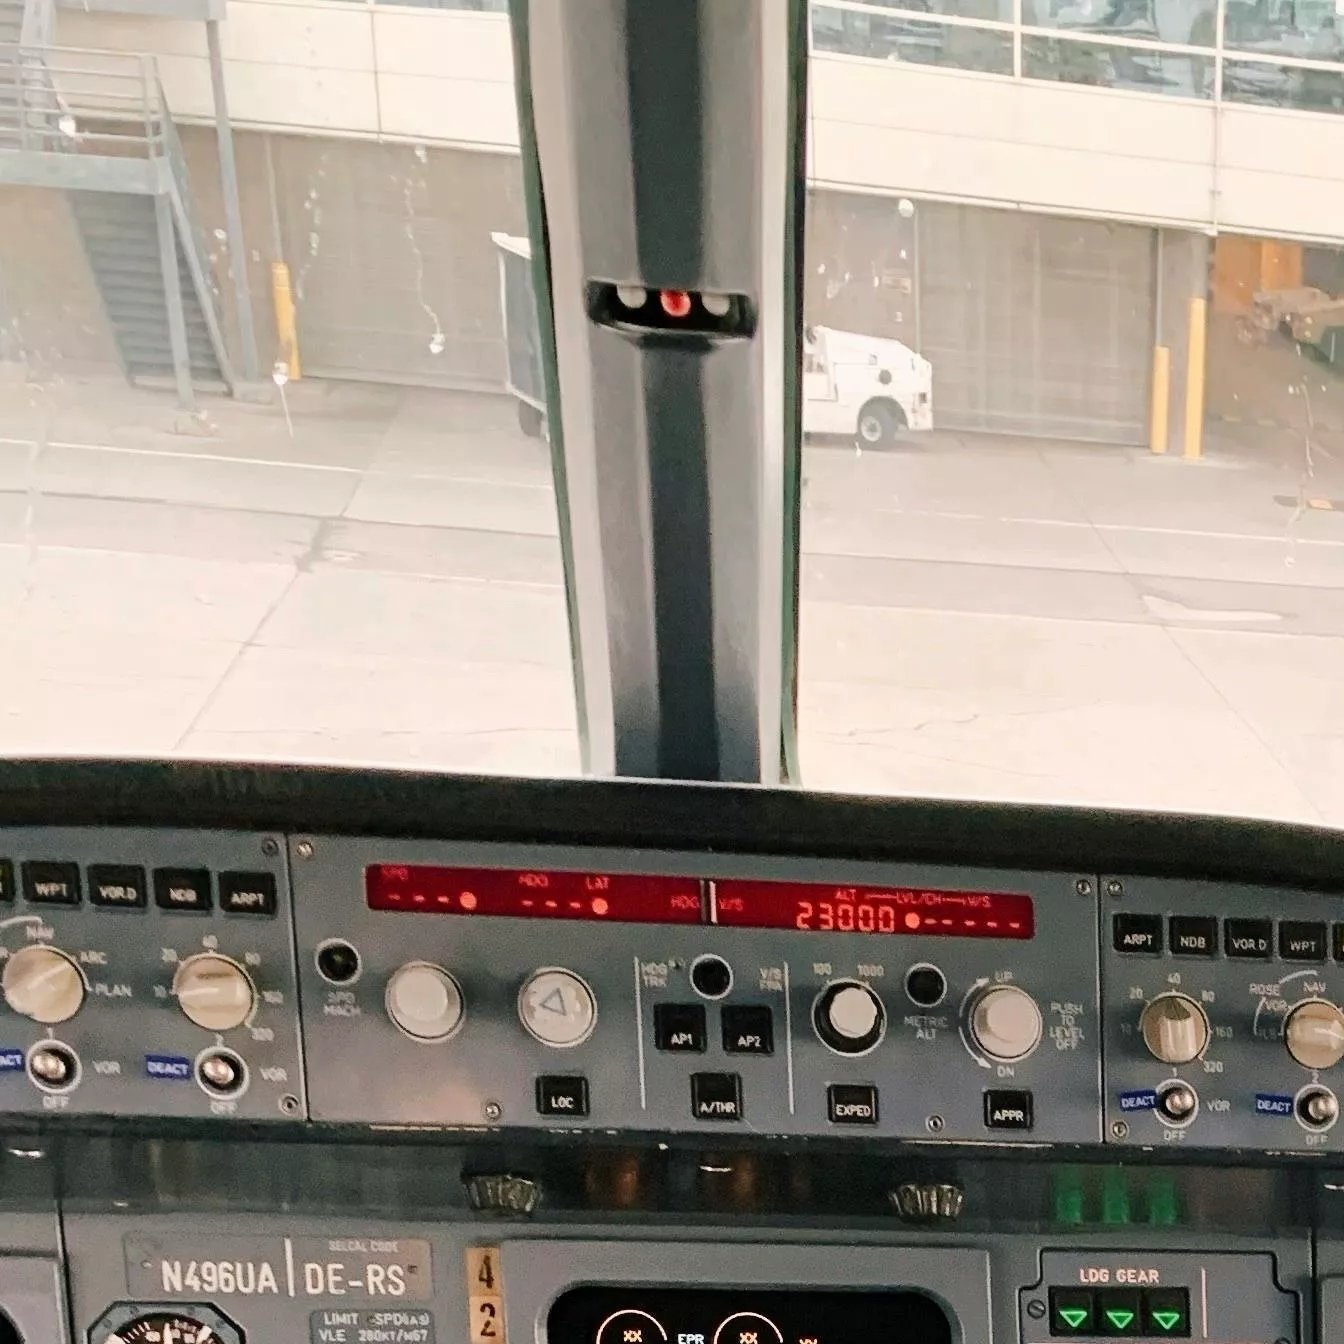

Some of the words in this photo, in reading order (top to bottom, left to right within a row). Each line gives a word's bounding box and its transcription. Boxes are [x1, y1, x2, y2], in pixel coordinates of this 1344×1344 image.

[34, 881, 68, 898] WPT
[230, 890, 265, 906] ARPT
[796, 902, 895, 933] 23000
[1123, 932, 1153, 947] ARPT
[1180, 935, 1206, 949] NDB
[1290, 939, 1316, 954] WPT
[1248, 983, 1280, 997] ROSE
[1303, 981, 1327, 994] NAV
[1050, 1003, 1083, 1015] PUSH
[904, 1016, 948, 1029] METRIC
[671, 1033, 693, 1047] AP1
[737, 1034, 761, 1048] AP2
[551, 1095, 574, 1110] LOC
[700, 1099, 735, 1115] A/THR
[1122, 1094, 1154, 1110] DEACT
[1207, 1100, 1230, 1113] VOR
[1257, 1099, 1290, 1114] DEACT
[835, 1103, 871, 1119] EXPED
[993, 1108, 1024, 1123] APPR
[161, 1261, 278, 1296] N496UA
[305, 1263, 407, 1297] DE-RS
[1080, 1269, 1109, 1283] LDG
[1116, 1269, 1159, 1283] GEAR
